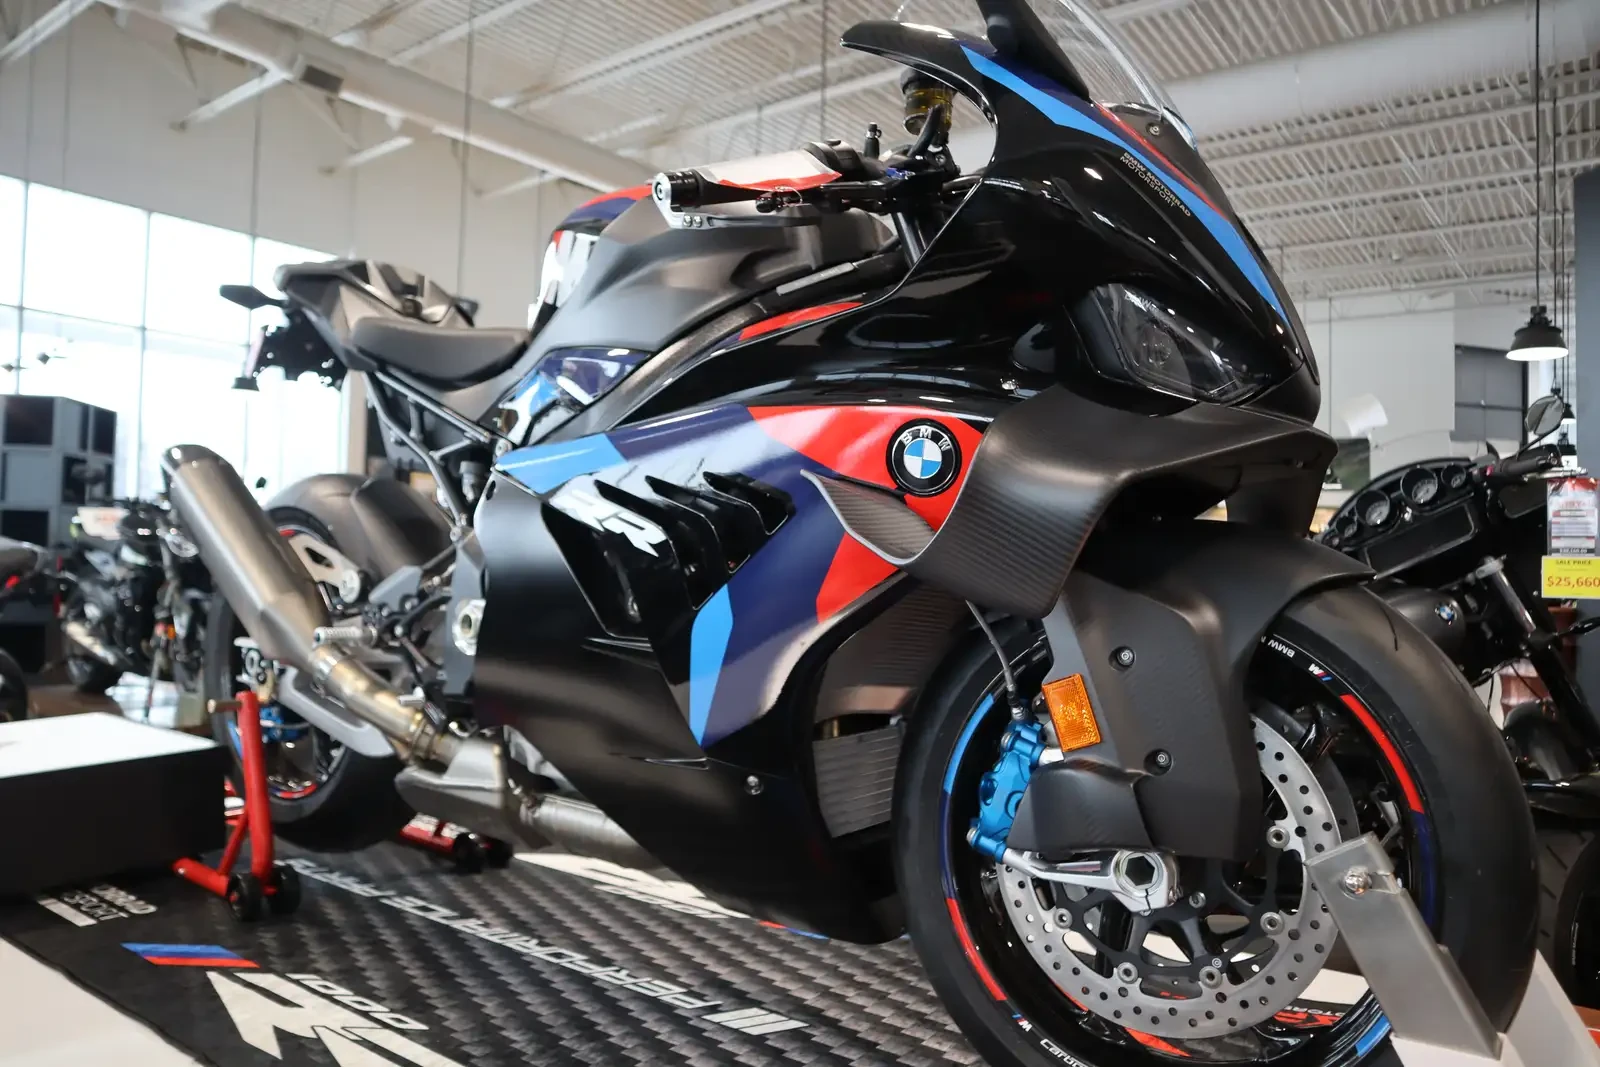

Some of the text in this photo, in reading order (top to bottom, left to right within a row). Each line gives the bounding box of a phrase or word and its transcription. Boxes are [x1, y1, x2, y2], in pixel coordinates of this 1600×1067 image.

[1120, 156, 1176, 207] MOTORSPORT
[1123, 152, 1191, 217] BMW MOTORRAD
[900, 427, 952, 452] BMW
[1547, 575, 1600, 589] $25,660
[1267, 639, 1296, 658] BMW
[379, 895, 724, 1009] PERFORMANCE
[285, 973, 430, 1031] 1000
